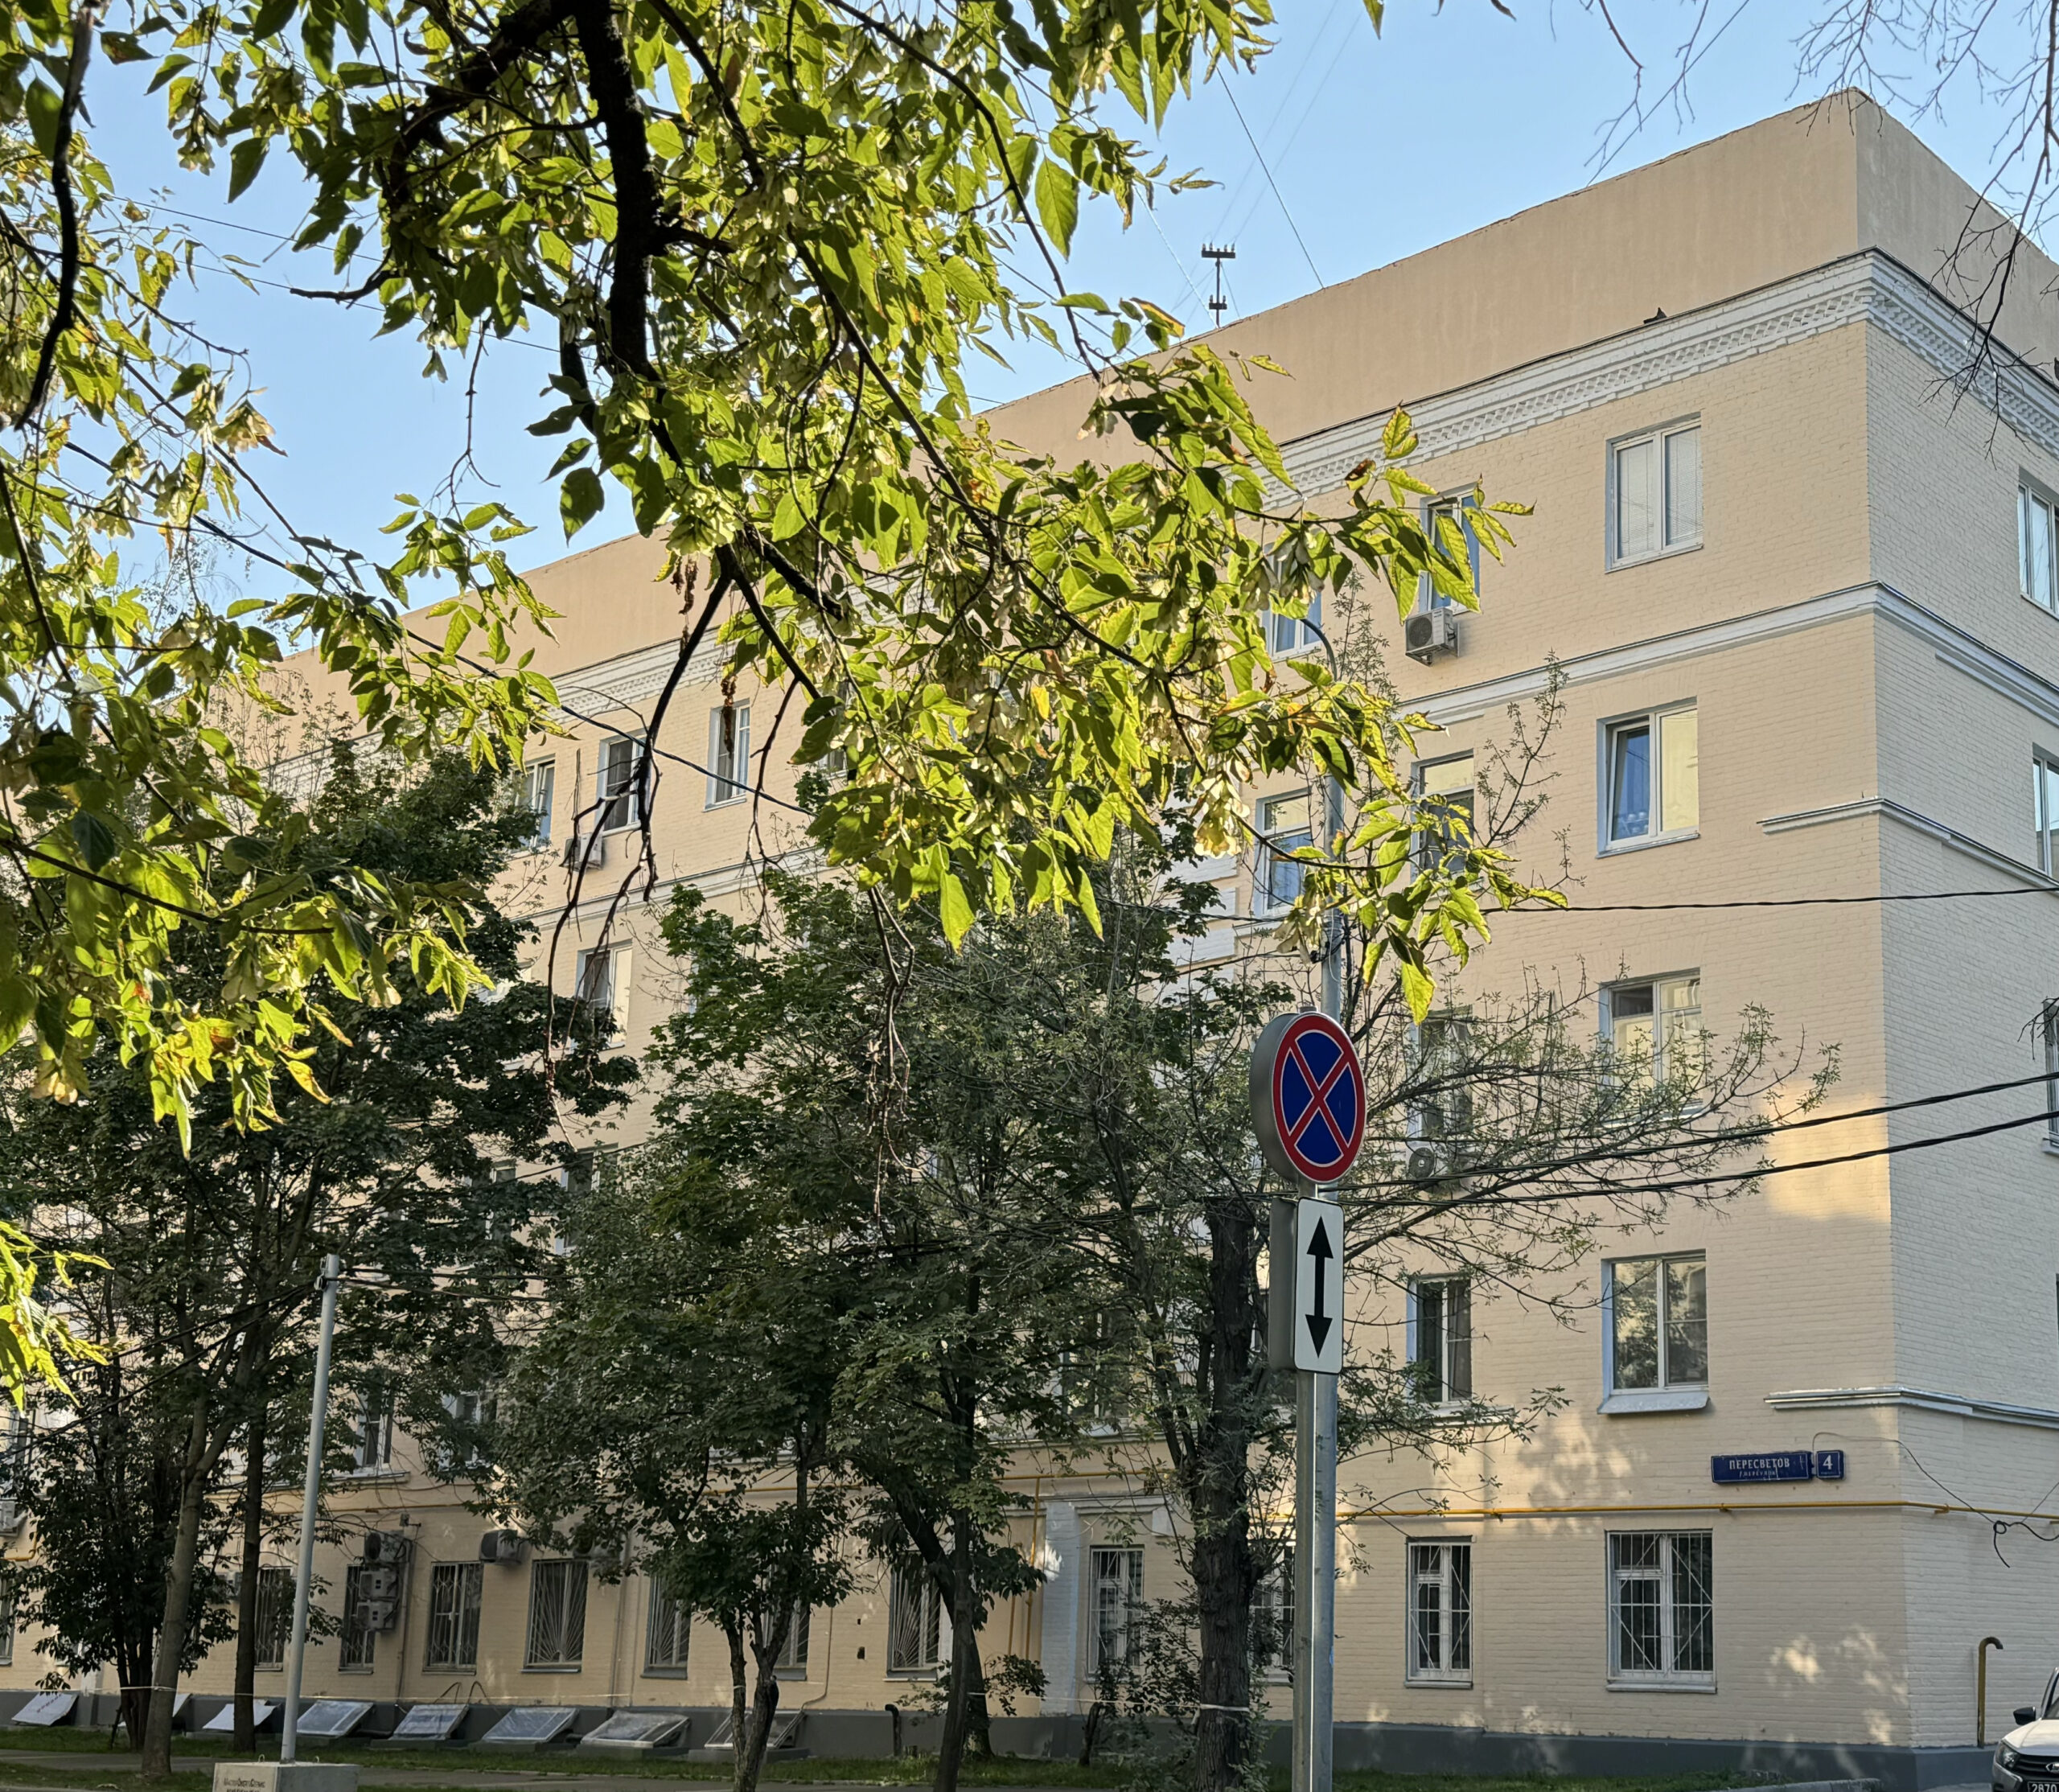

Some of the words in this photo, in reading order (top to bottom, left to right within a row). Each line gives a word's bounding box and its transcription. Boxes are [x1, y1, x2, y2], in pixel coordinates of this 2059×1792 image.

[1729, 1458, 1790, 1470] ПЕРЕСВЕТОВ
[1823, 1454, 1833, 1470] 4
[2032, 1783, 2057, 1792] 2870
